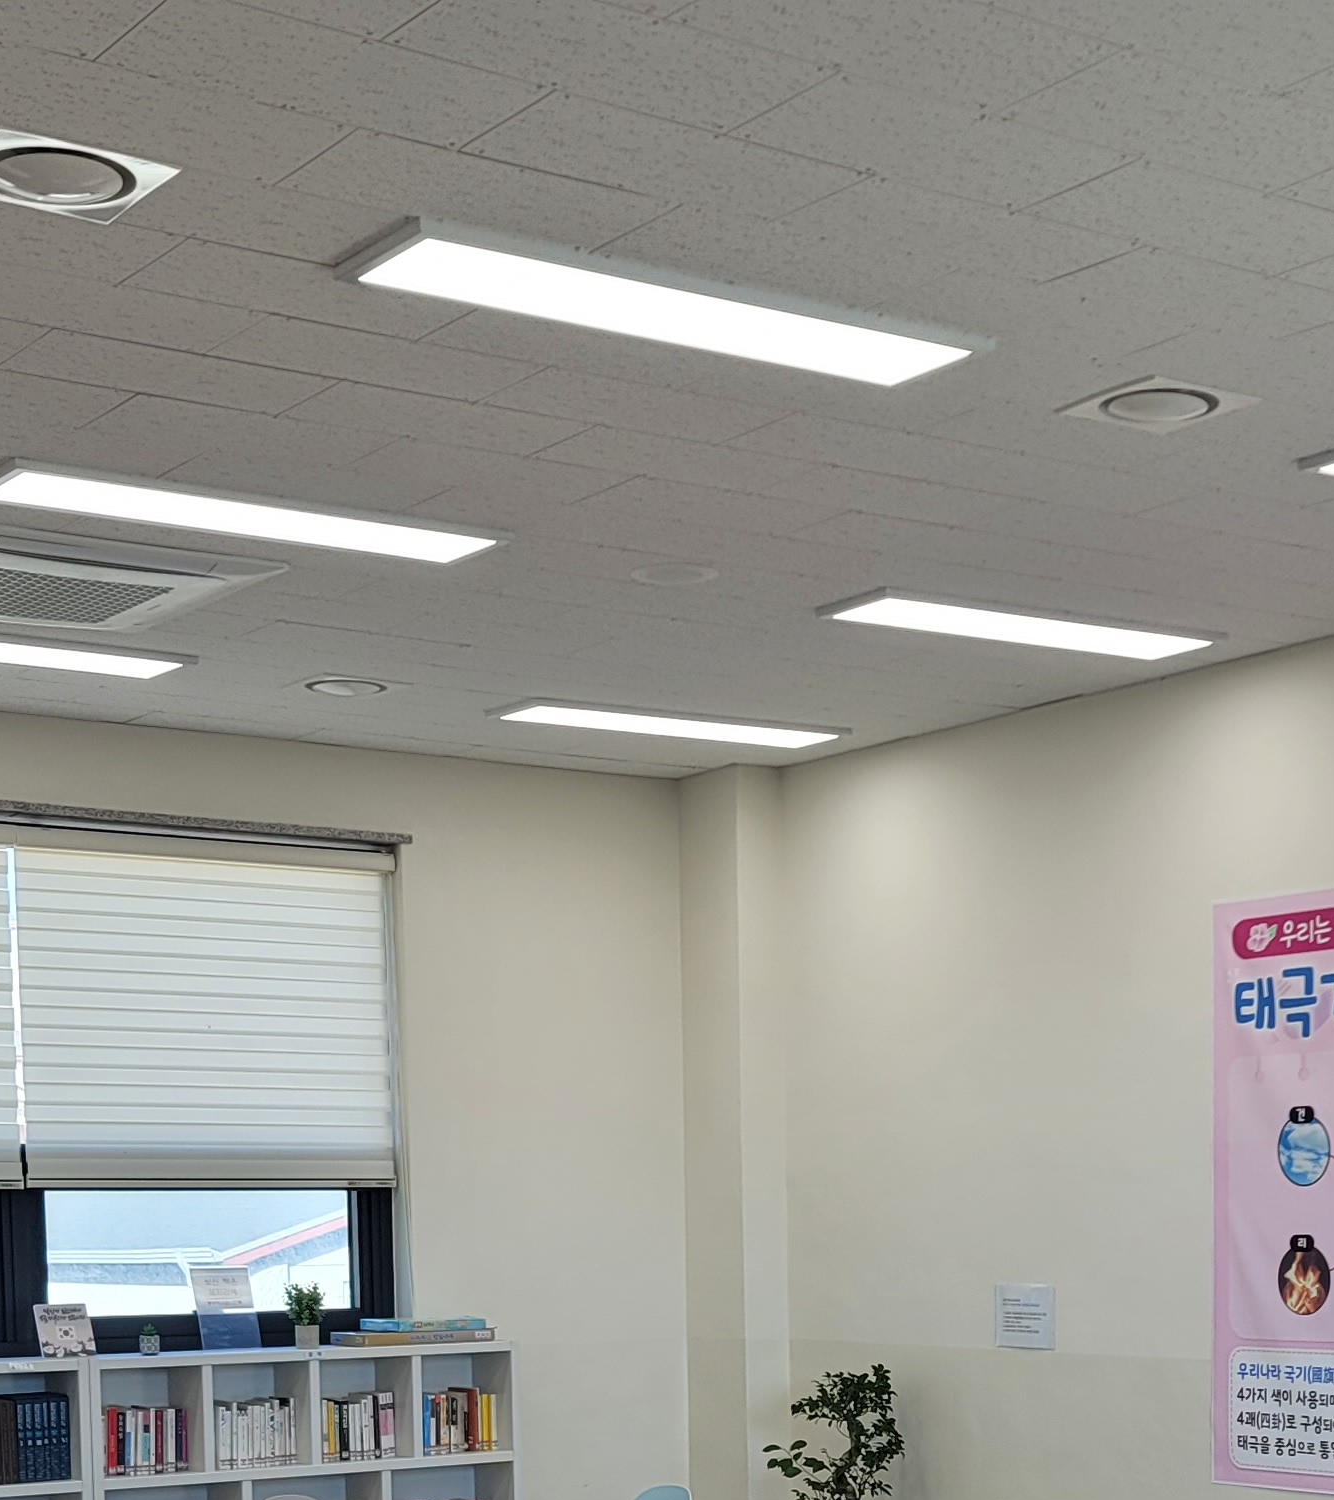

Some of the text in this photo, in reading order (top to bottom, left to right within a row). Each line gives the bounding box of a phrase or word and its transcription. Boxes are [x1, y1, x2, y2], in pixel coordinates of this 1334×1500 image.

[1279, 916, 1332, 948] 우리는
[1296, 1108, 1306, 1122] 건
[1297, 1238, 1307, 1248] 리
[1237, 1363, 1282, 1380] 우리나라
[1237, 1387, 1267, 1405] 4가지
[1271, 1389, 1292, 1407] 색이
[1237, 1411, 1297, 1431] 4괘(四卦)로
[1237, 1435, 1271, 1454] 태극을
[1274, 1438, 1316, 1457] 중심으로
